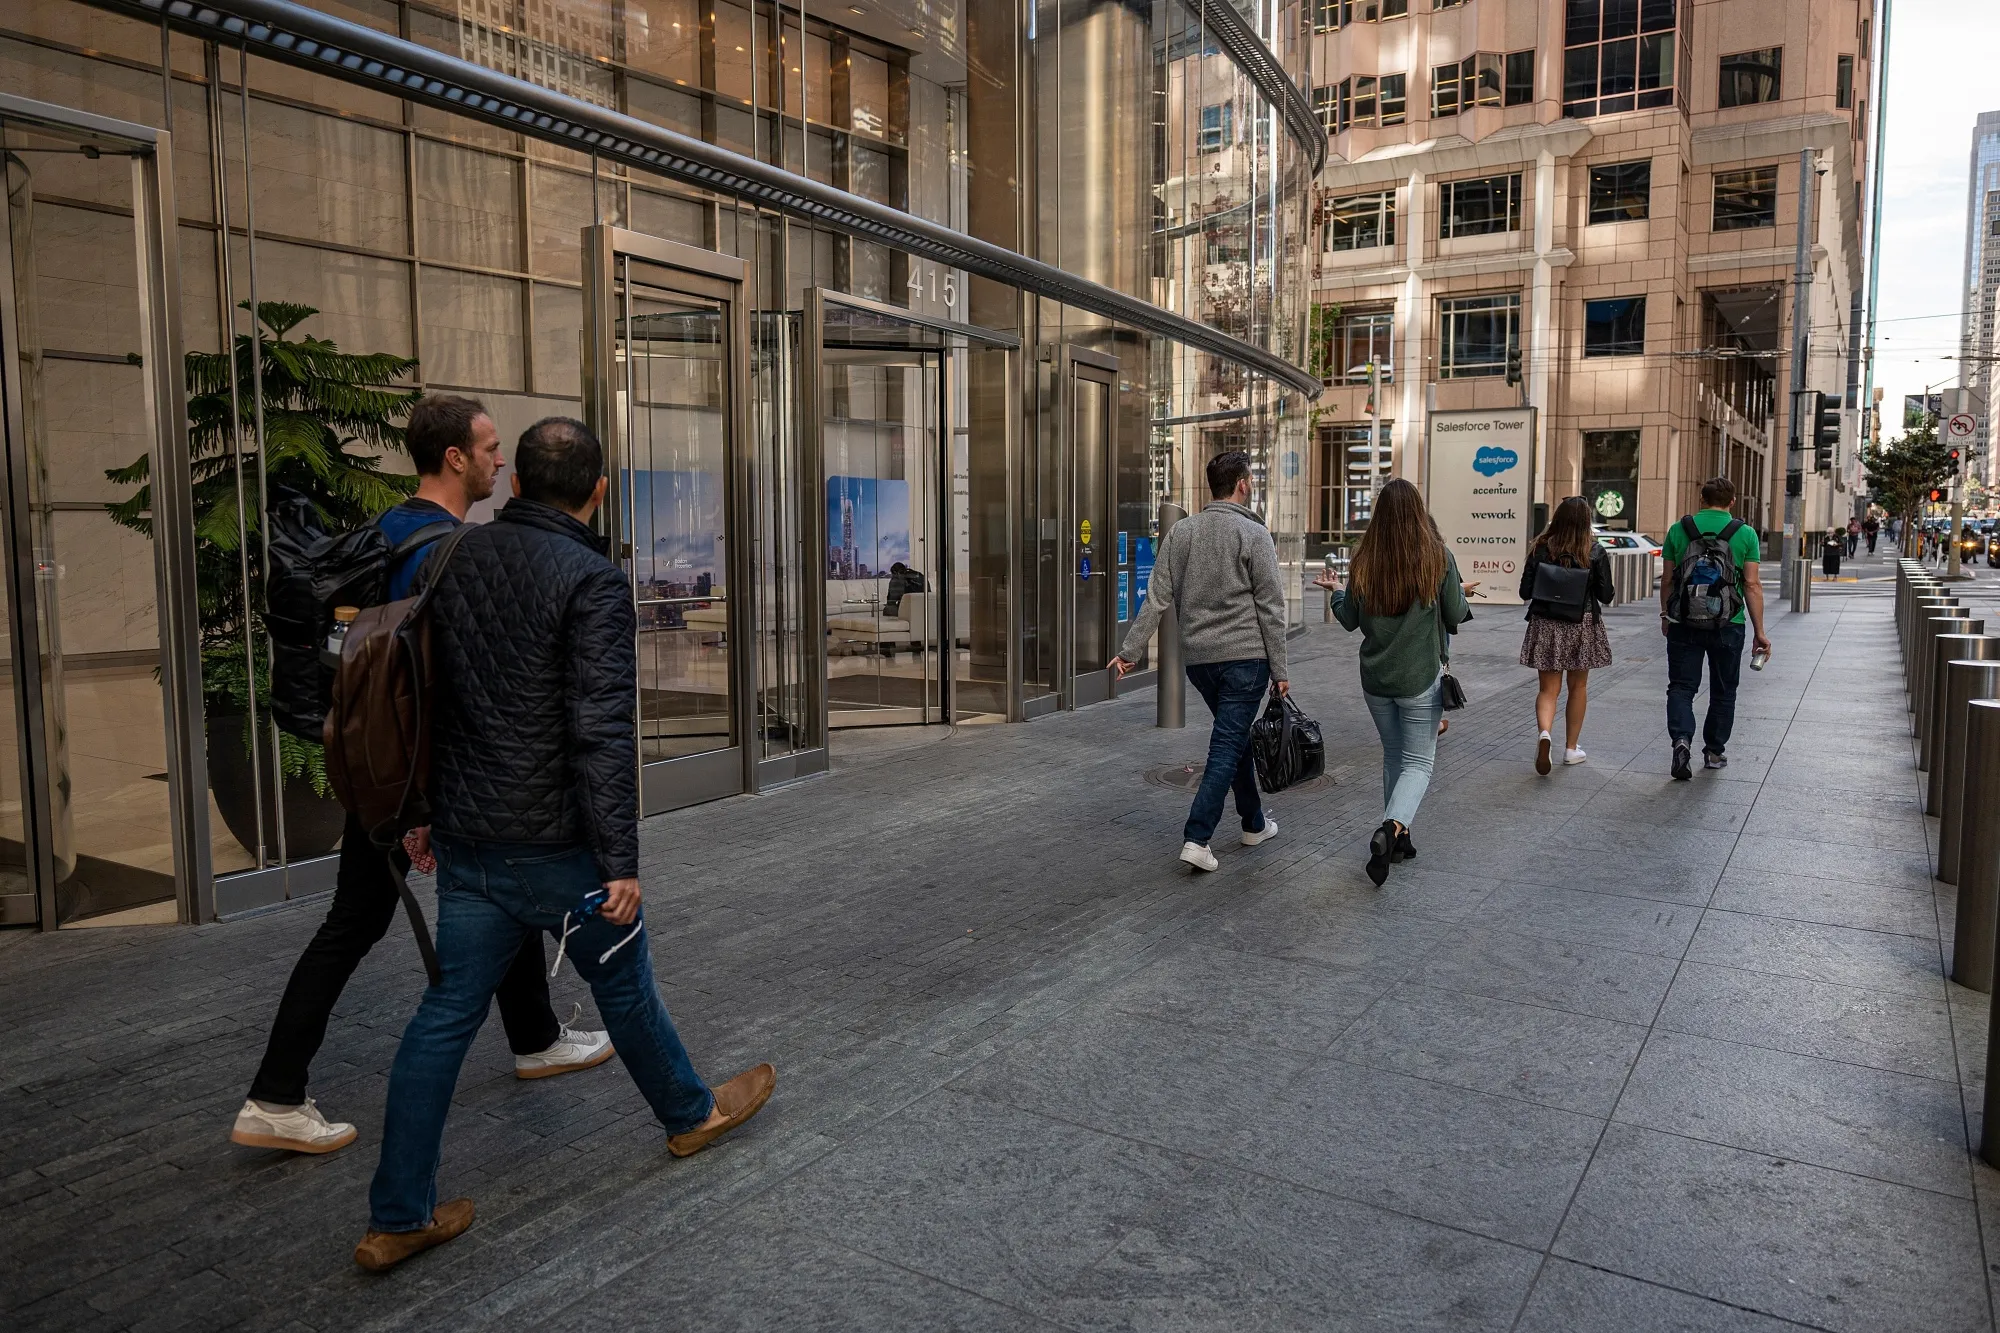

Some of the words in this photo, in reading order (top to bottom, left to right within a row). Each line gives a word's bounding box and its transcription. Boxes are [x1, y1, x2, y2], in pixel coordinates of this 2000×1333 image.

[907, 265, 956, 307] 415
[1436, 422, 1491, 432] Salesforce
[1493, 420, 1524, 430] Tower
[1479, 456, 1515, 465] salesforce
[1473, 486, 1518, 495] accenture
[1471, 508, 1516, 519] wework
[1473, 560, 1500, 569] BAIN
